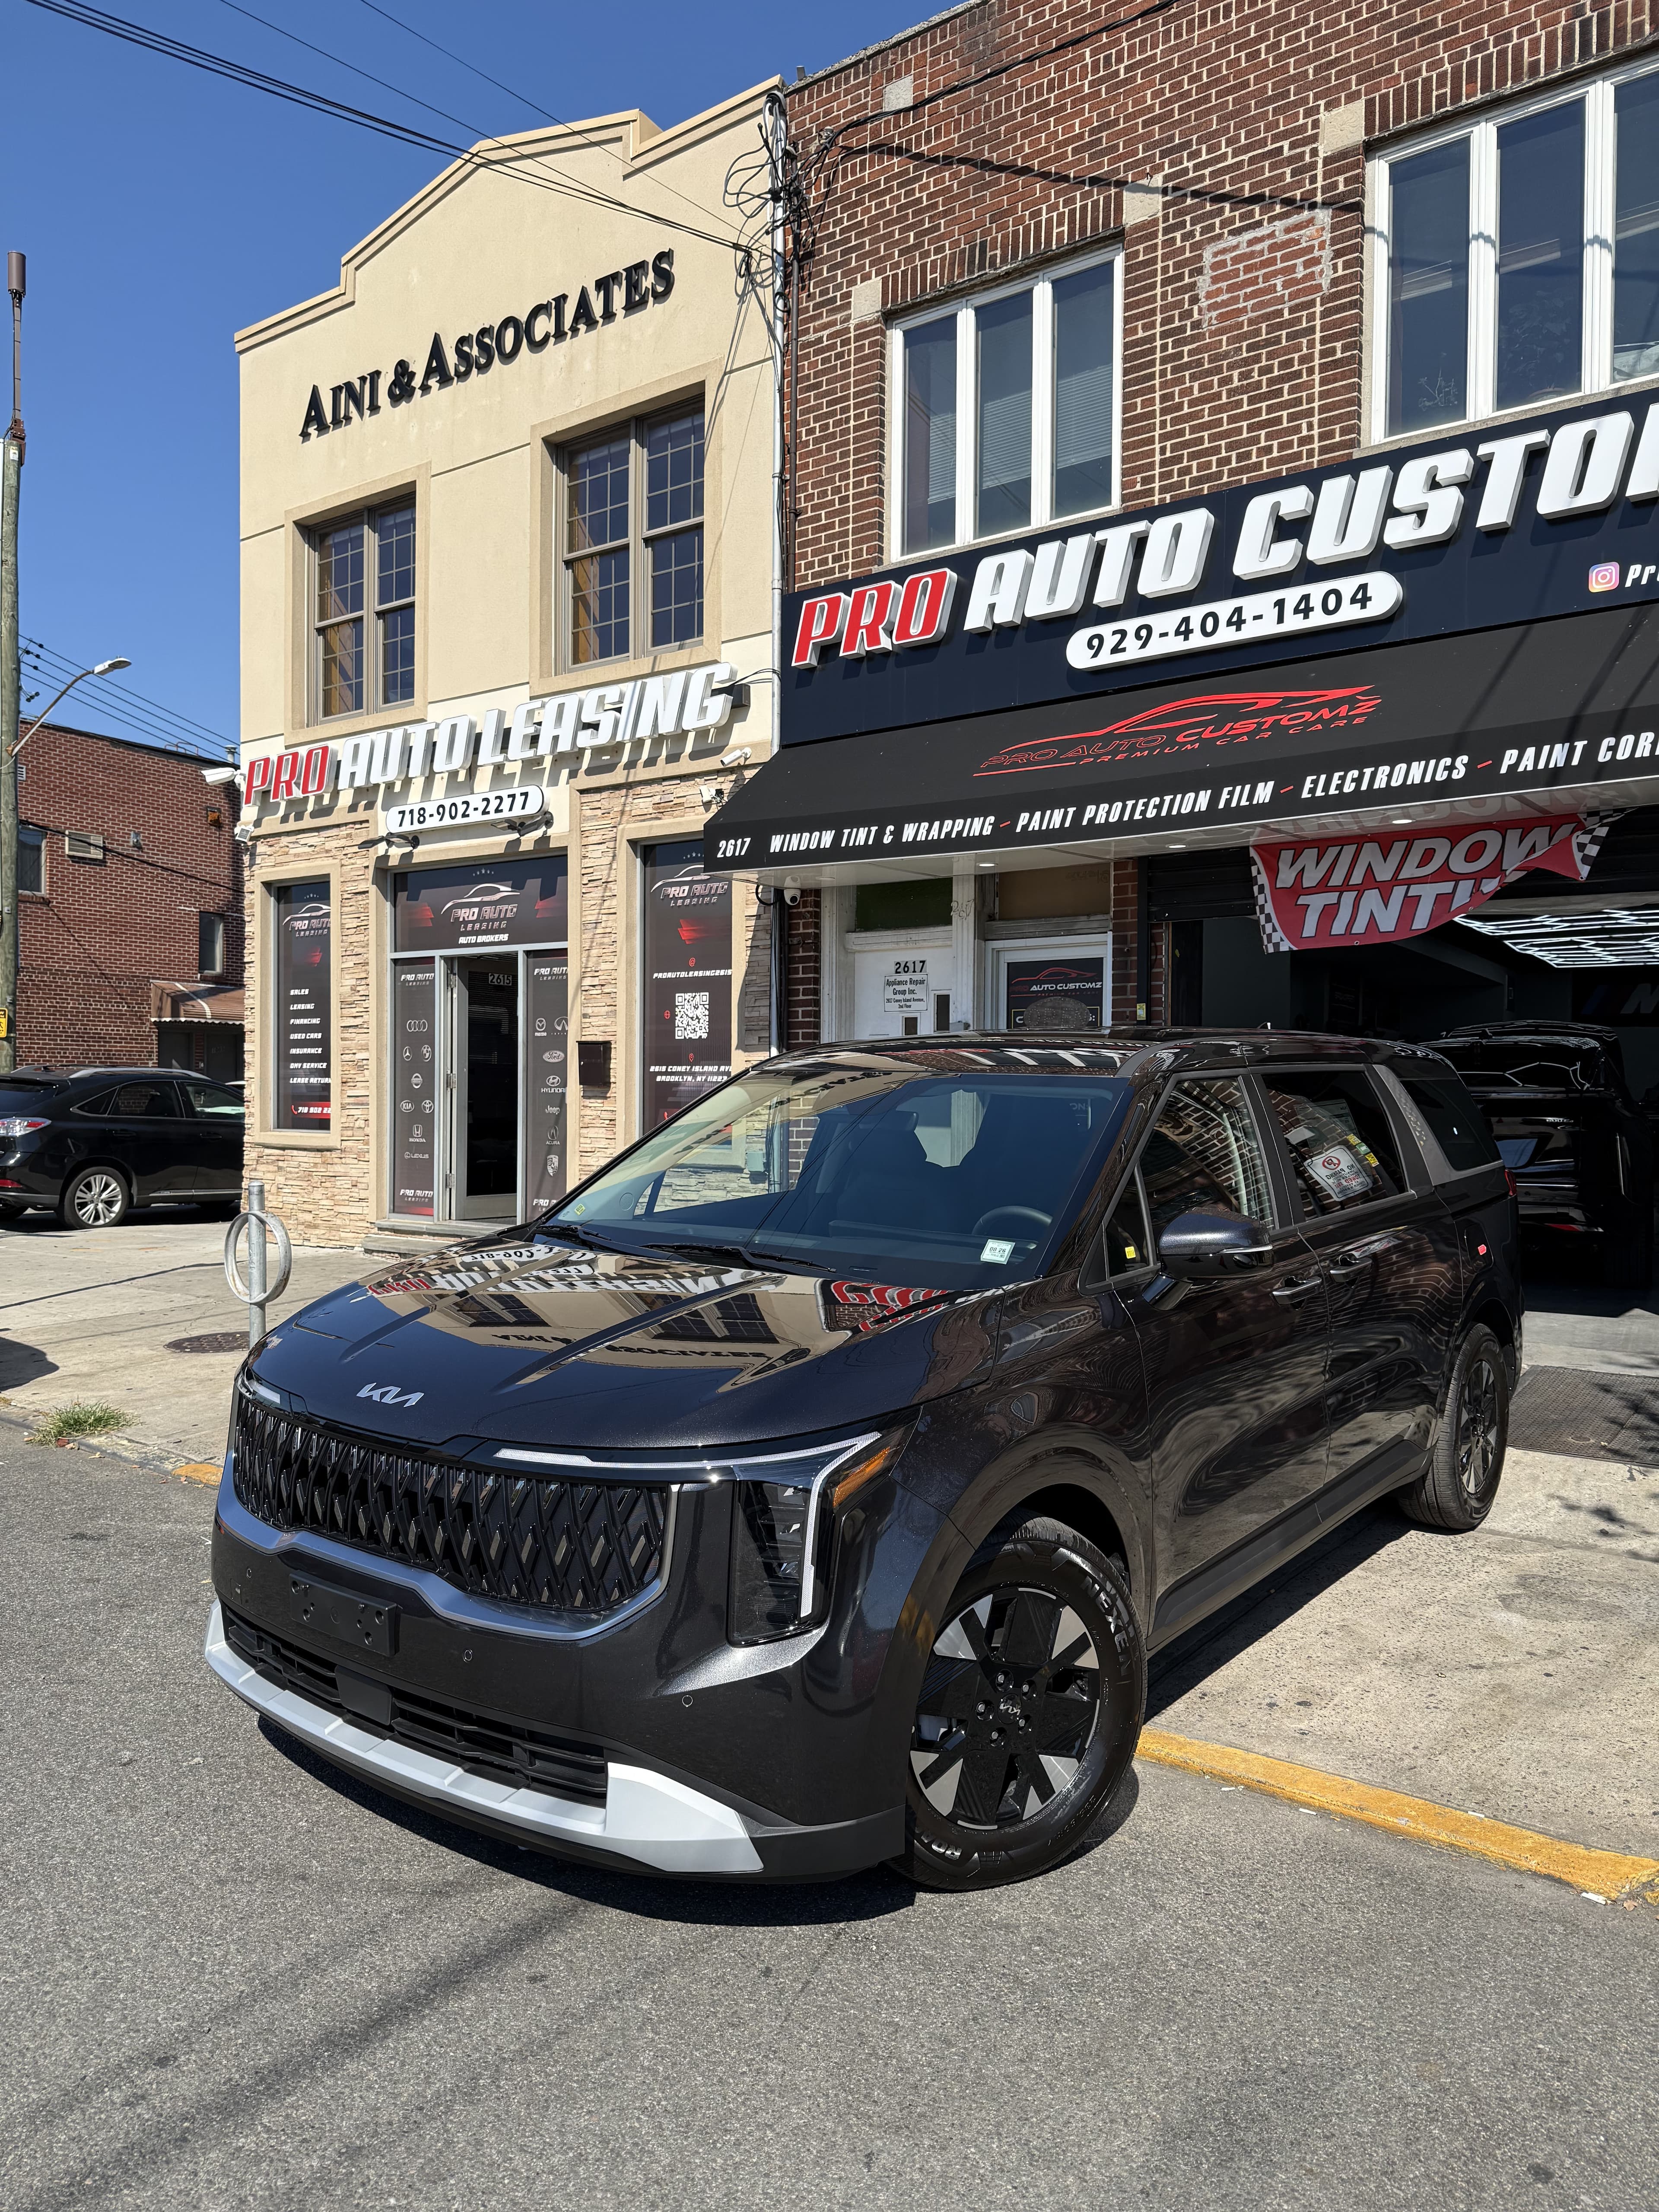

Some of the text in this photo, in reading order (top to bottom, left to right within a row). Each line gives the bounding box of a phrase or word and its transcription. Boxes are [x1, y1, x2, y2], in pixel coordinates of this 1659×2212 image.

[299, 248, 675, 438] AINI & ASSOCIATES
[1625, 564, 1659, 587] Pr
[791, 568, 956, 669] PRO
[964, 507, 1214, 633] AUTO
[1087, 583, 1373, 659] 929-404-1404
[244, 662, 737, 807] PRO AUTO LEASING
[980, 695, 1382, 768] PRO AUTO CUSTOMZ
[1080, 716, 1368, 765] PREMIUM CAR CARE
[717, 838, 751, 858] 2617
[769, 830, 836, 853] WINDOW
[840, 826, 878, 847] TINT
[883, 825, 894, 844] &
[902, 816, 995, 842] WRAPPING
[1015, 807, 1076, 833] PAINT
[1081, 790, 1211, 826] PROTECTION
[1218, 781, 1274, 809] FILM
[1301, 756, 1469, 798] ELECTRONICS
[1499, 741, 1588, 774] PAINT
[1597, 731, 1659, 763] COR
[398, 792, 529, 827] 718-902-2277
[1275, 822, 1578, 889] WINDOW
[661, 882, 729, 899] PRO AUTO
[671, 897, 718, 907] LEASING
[451, 904, 518, 922] PRO AUTO
[289, 920, 308, 931] PRO
[461, 921, 508, 931] LEASING
[477, 934, 509, 943] BROKERS
[689, 957, 696, 966] @
[895, 960, 926, 974] 2617
[489, 975, 512, 985] 2615
[653, 969, 732, 979] PROAUTOLEASING2615
[886, 978, 925, 987] Appliance Repair
[545, 1106, 560, 1115] Jeep
[356, 1383, 424, 1407] KIA
[1081, 1575, 1131, 1676] NEXEN
